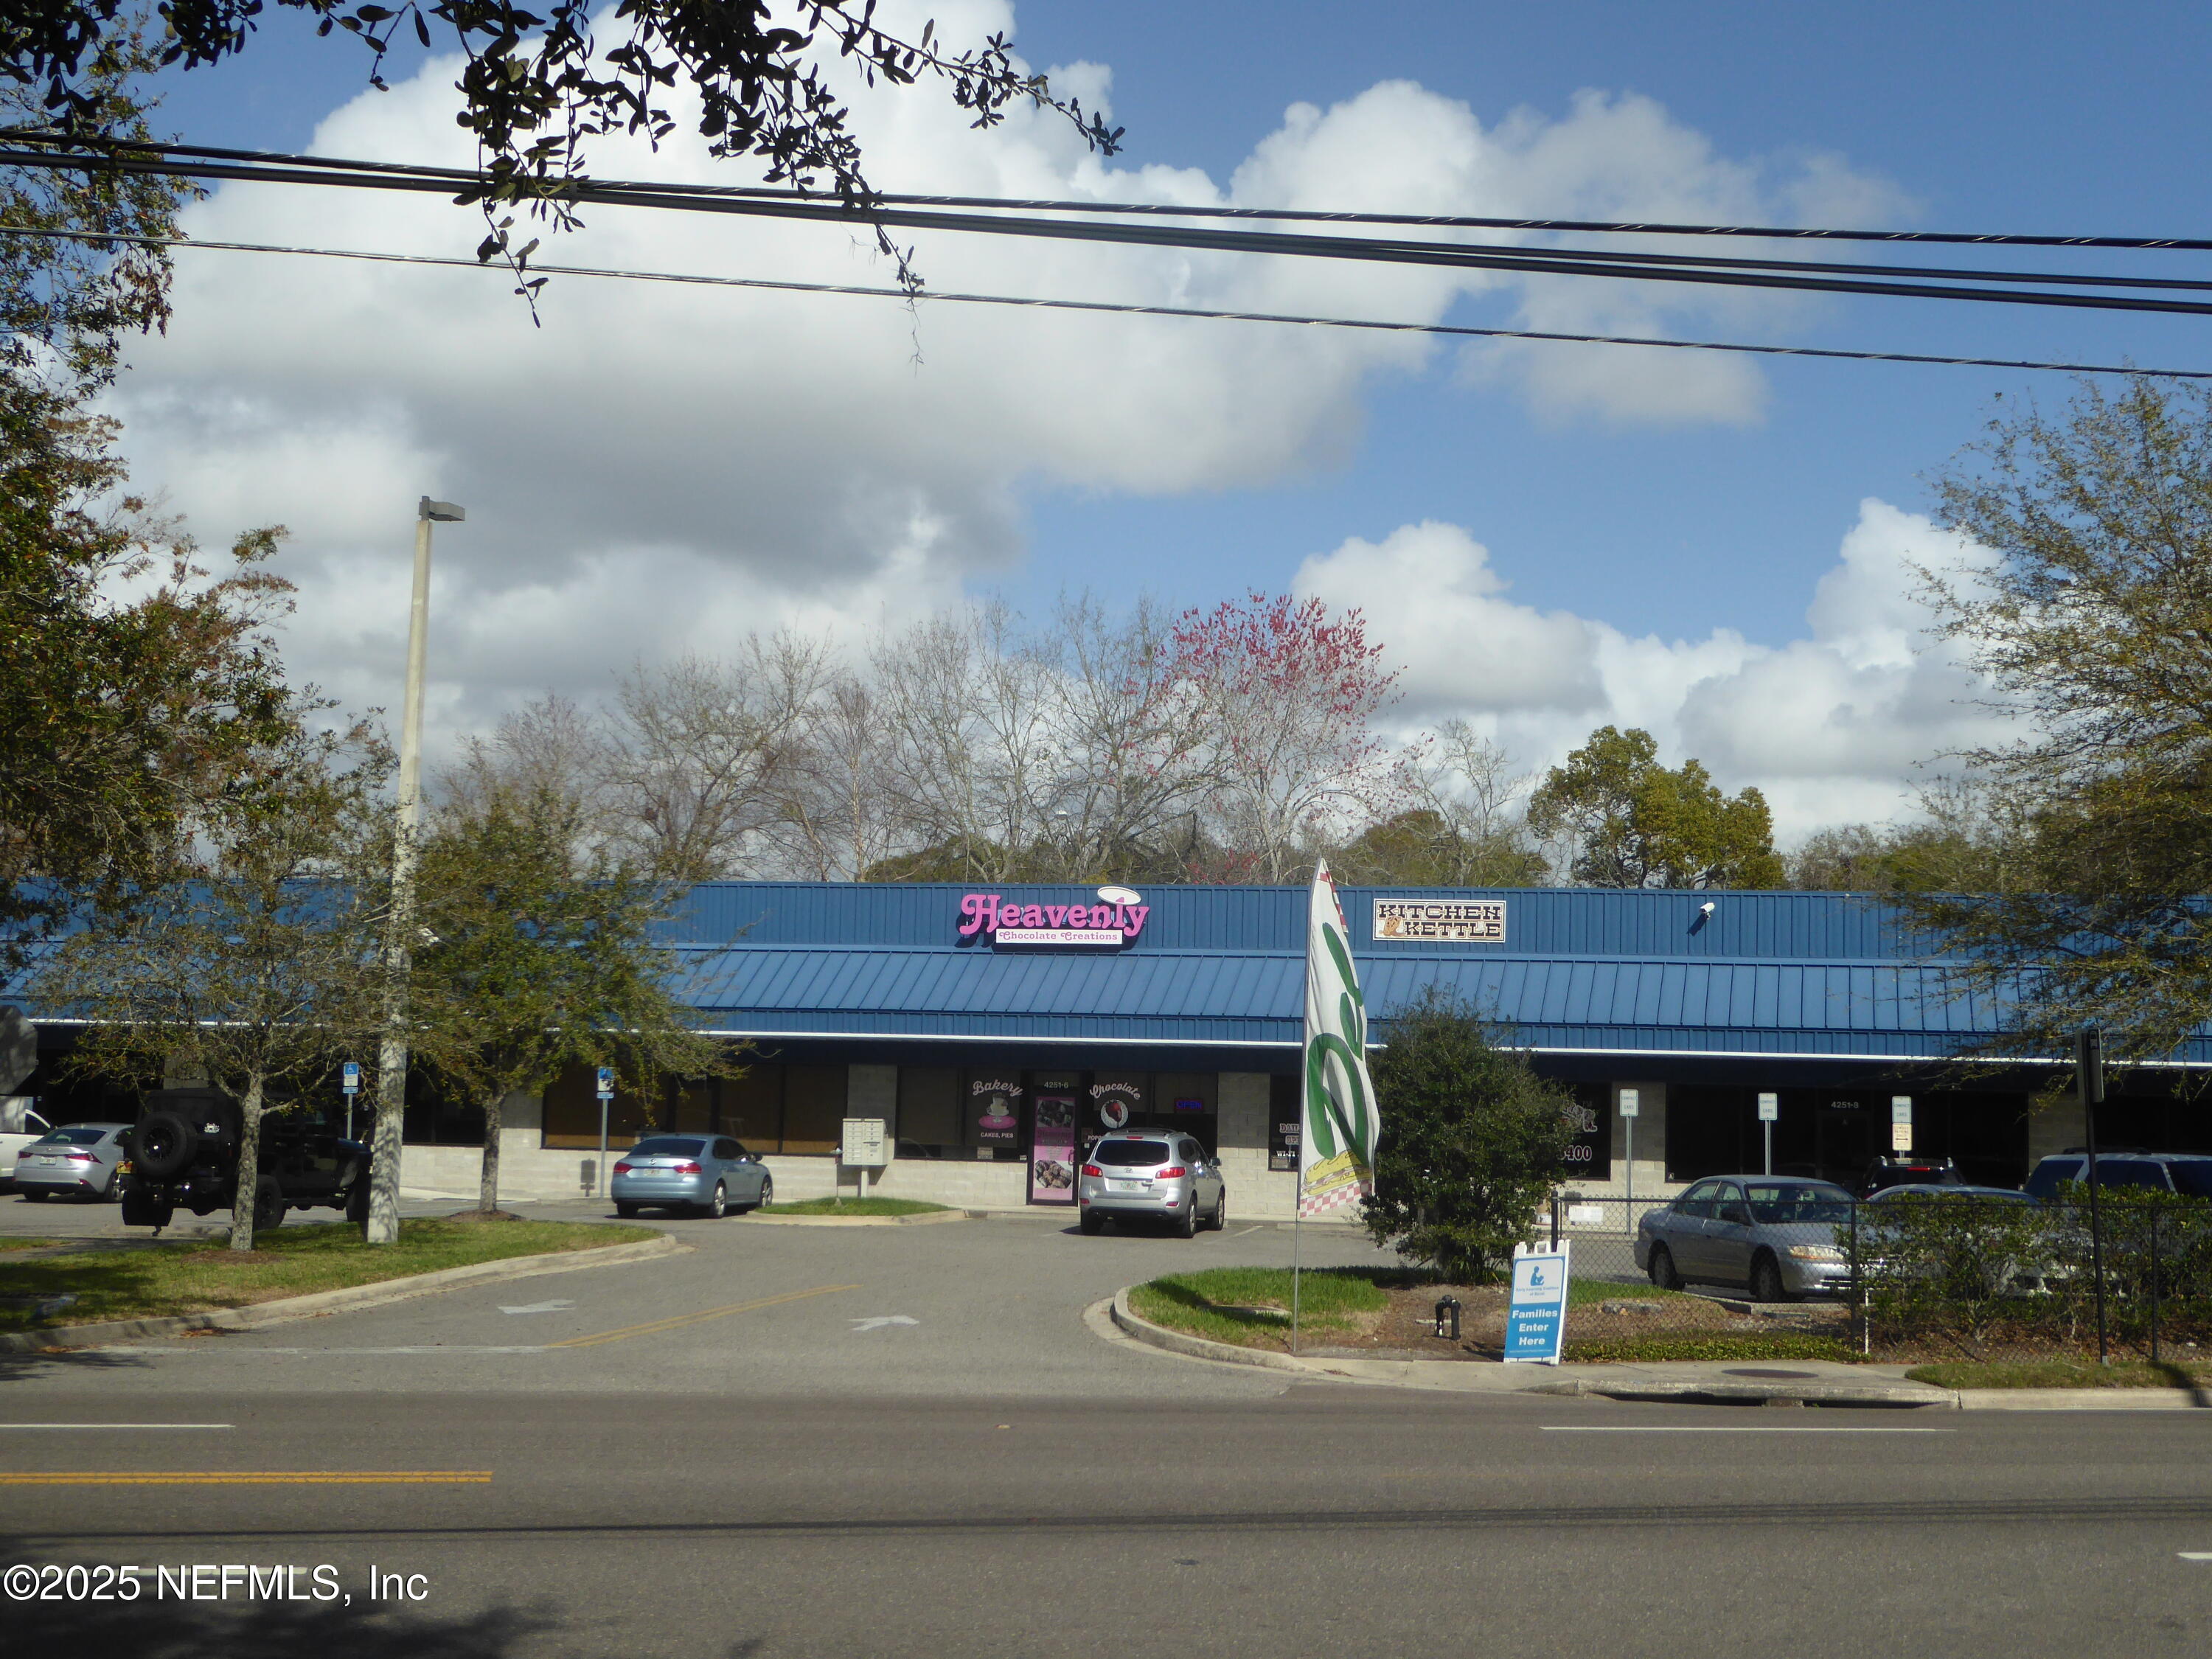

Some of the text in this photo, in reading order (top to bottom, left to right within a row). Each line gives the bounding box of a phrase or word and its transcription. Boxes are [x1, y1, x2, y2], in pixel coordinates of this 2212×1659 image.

[959, 894, 1150, 936] Heavenly
[1378, 904, 1501, 920] KITCHEN
[1405, 922, 1501, 937] KETTLE
[999, 931, 1118, 941] Chocolate Creations
[973, 1079, 1023, 1097] Bakery
[1089, 1082, 1141, 1100] Chocolate
[1831, 1101, 1859, 1109] 4251-8
[1512, 1309, 1558, 1319] Families
[1519, 1323, 1549, 1332] Enter
[1519, 1337, 1545, 1346] Here
